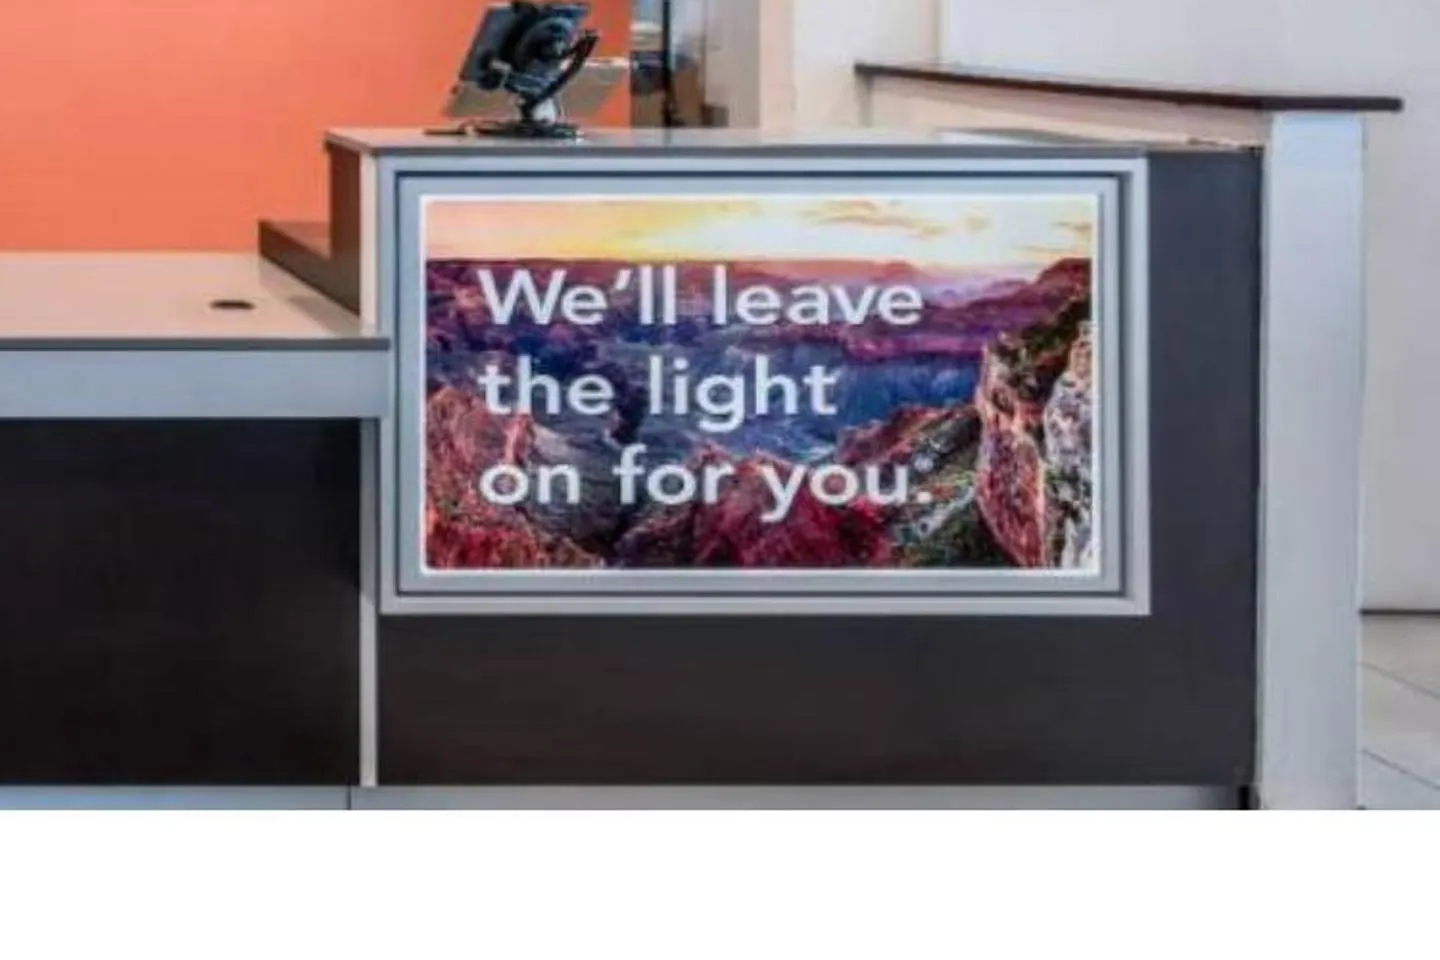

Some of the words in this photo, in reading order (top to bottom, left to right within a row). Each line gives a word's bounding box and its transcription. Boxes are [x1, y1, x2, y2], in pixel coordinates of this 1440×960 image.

[713, 264, 924, 327] leave
[477, 355, 614, 417] the
[648, 355, 838, 433] light
[478, 463, 580, 507] on
[612, 443, 736, 506] for
